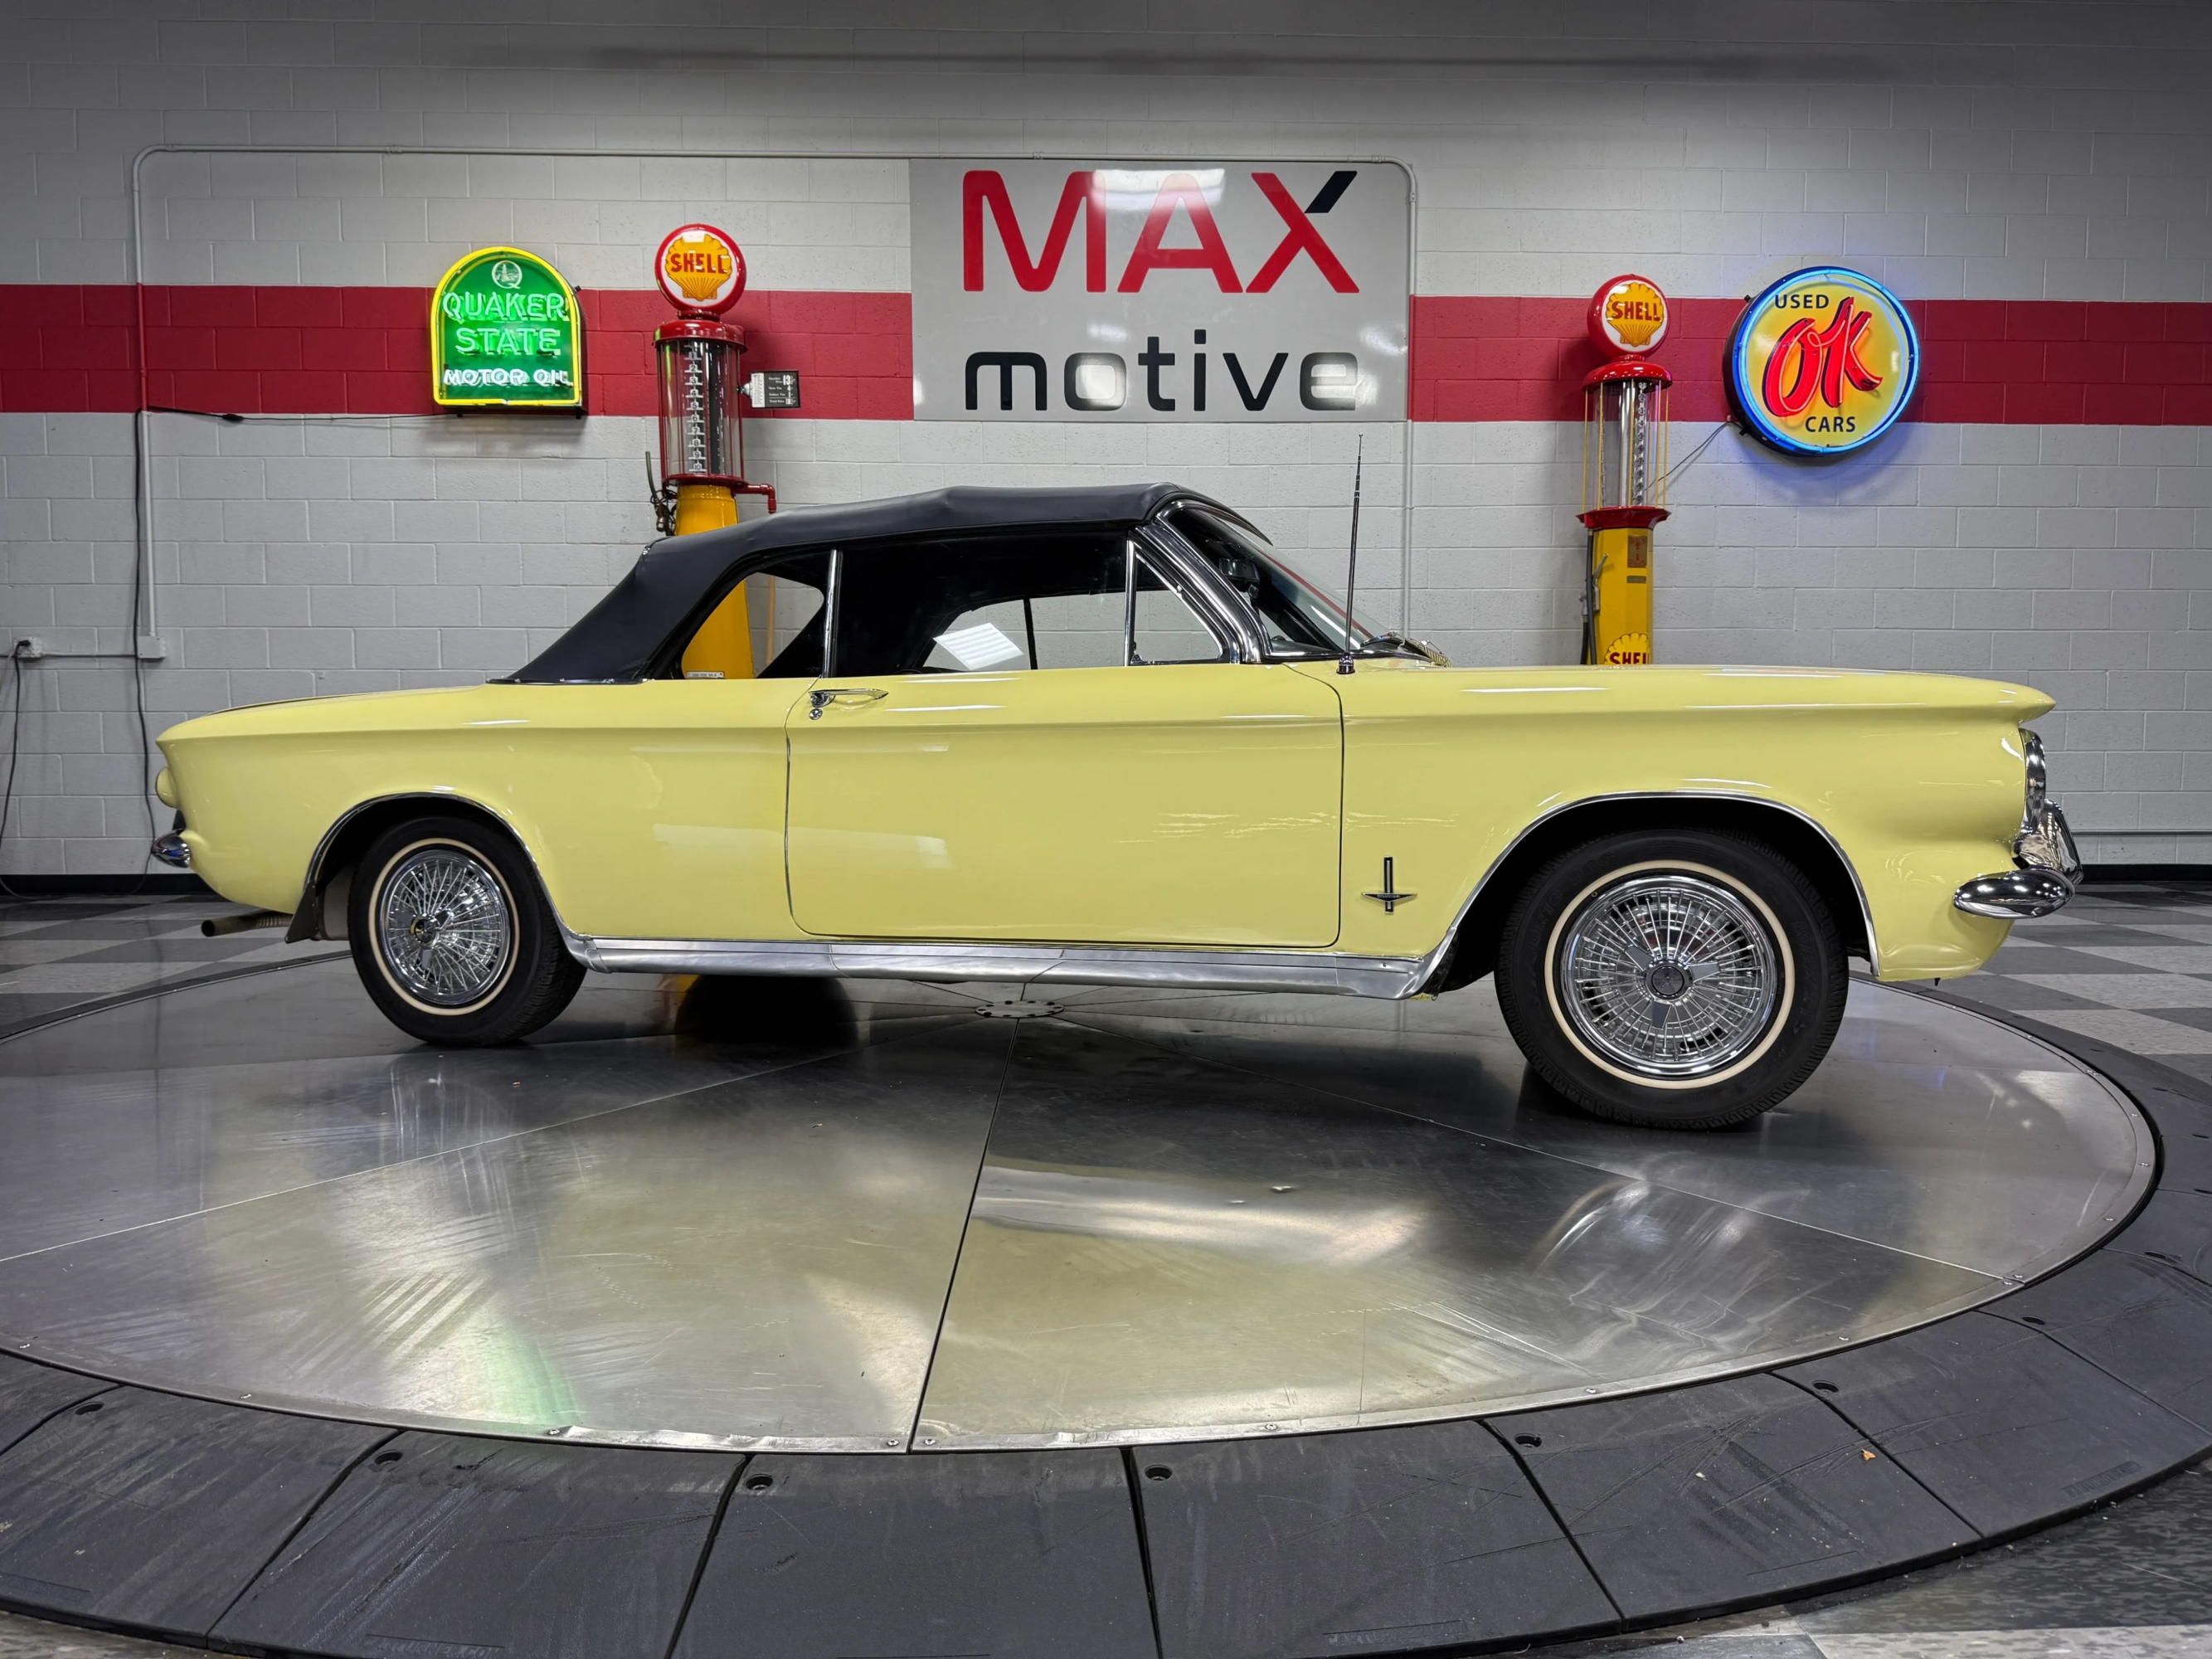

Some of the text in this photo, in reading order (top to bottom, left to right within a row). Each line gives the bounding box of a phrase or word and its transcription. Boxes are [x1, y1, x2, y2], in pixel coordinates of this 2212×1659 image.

[963, 170, 1359, 293] MAX
[670, 253, 727, 275] SHELL
[443, 292, 570, 322] QUAKER
[1612, 301, 1660, 321] SHELL
[1774, 294, 1830, 309] USED
[455, 328, 561, 355] STATE
[1762, 296, 1884, 417] OK
[444, 368, 573, 387] MOTOR OIL
[965, 329, 1358, 411] motive
[1805, 416, 1856, 432] CARS
